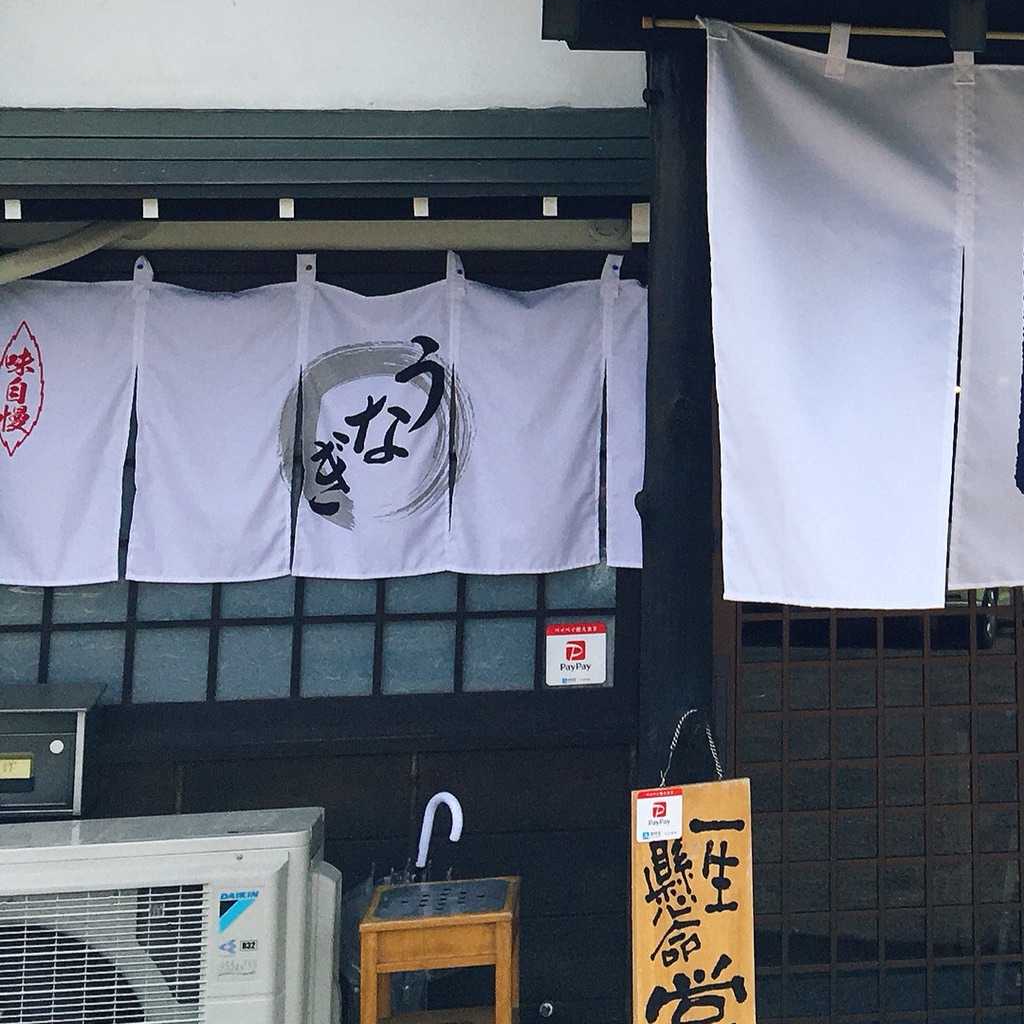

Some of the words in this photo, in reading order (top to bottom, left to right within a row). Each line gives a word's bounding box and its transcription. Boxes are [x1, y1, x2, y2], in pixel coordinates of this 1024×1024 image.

[0, 347, 35, 436] 味自慢
[309, 335, 446, 515] うなぎ
[560, 662, 592, 672] PayPay
[220, 890, 259, 900] DAIKIN
